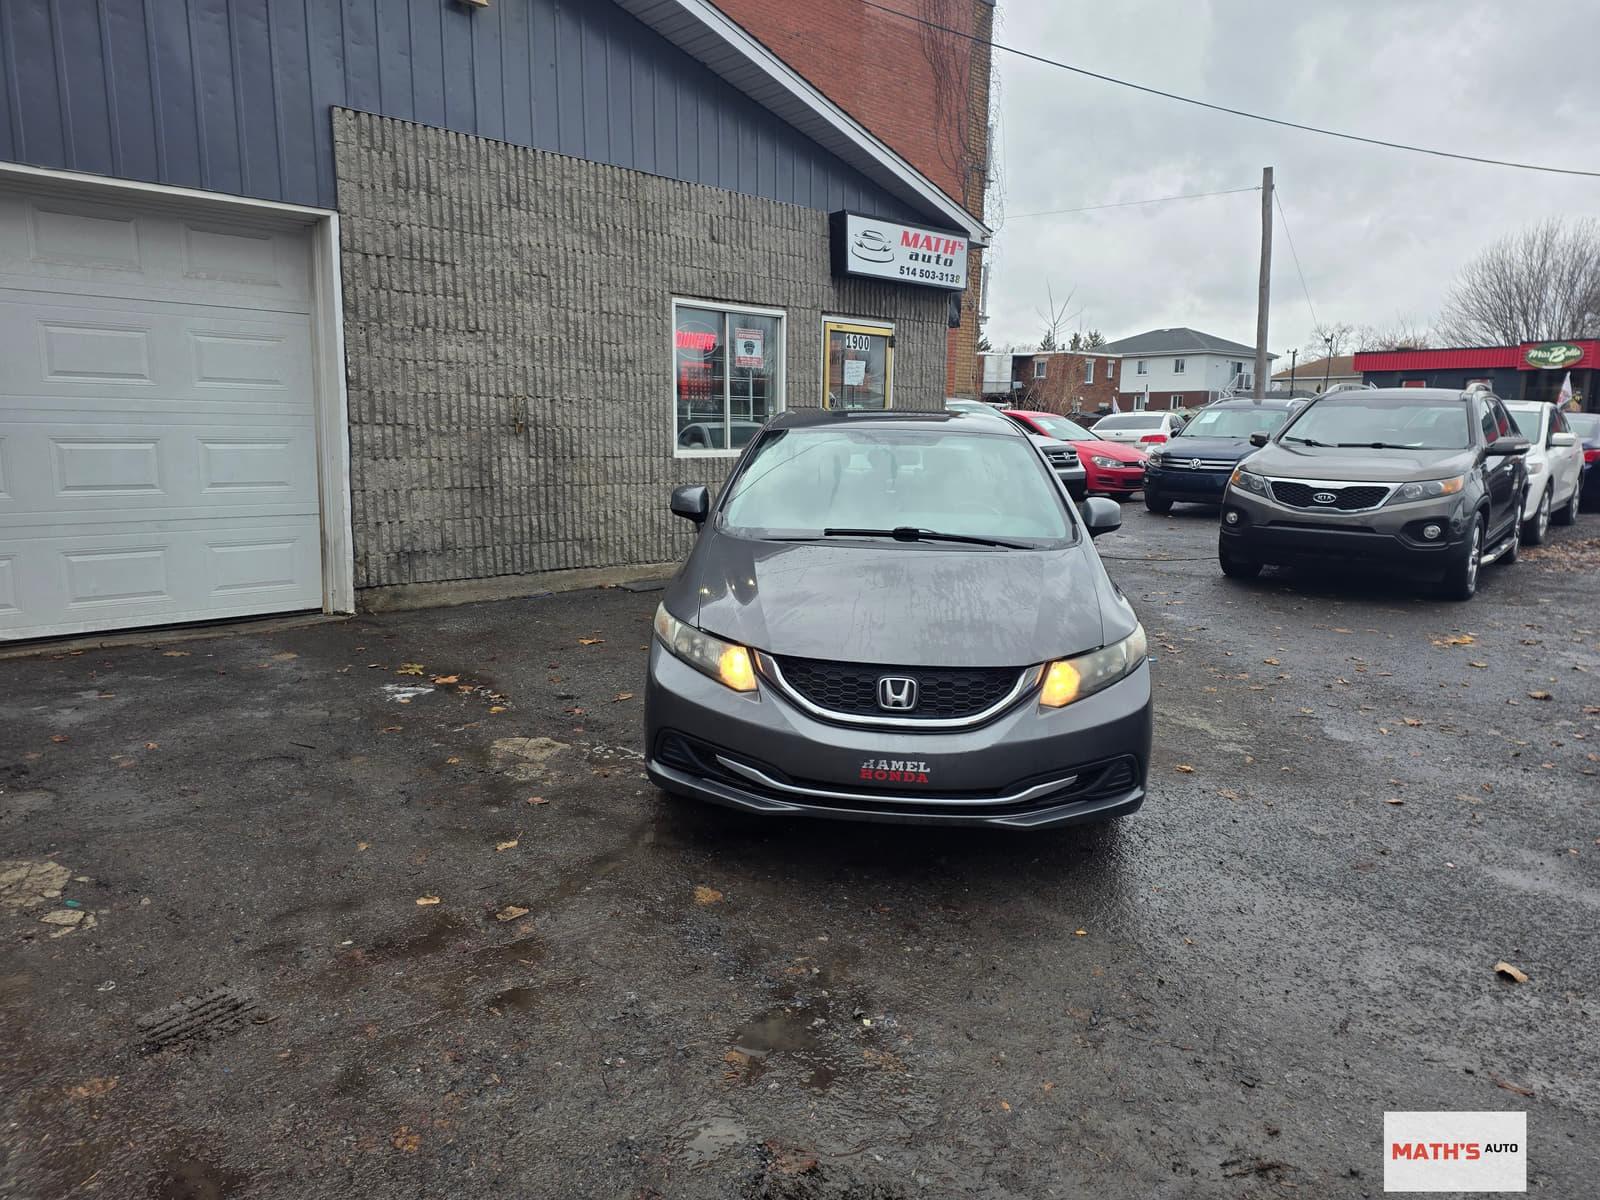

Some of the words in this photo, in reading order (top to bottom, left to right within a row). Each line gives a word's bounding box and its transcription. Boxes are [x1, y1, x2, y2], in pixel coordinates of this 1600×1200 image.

[909, 251, 954, 267] auto
[899, 265, 917, 277] 514
[919, 268, 960, 284] 503-3138
[846, 334, 870, 351] 1900
[860, 768, 929, 784] HONDA
